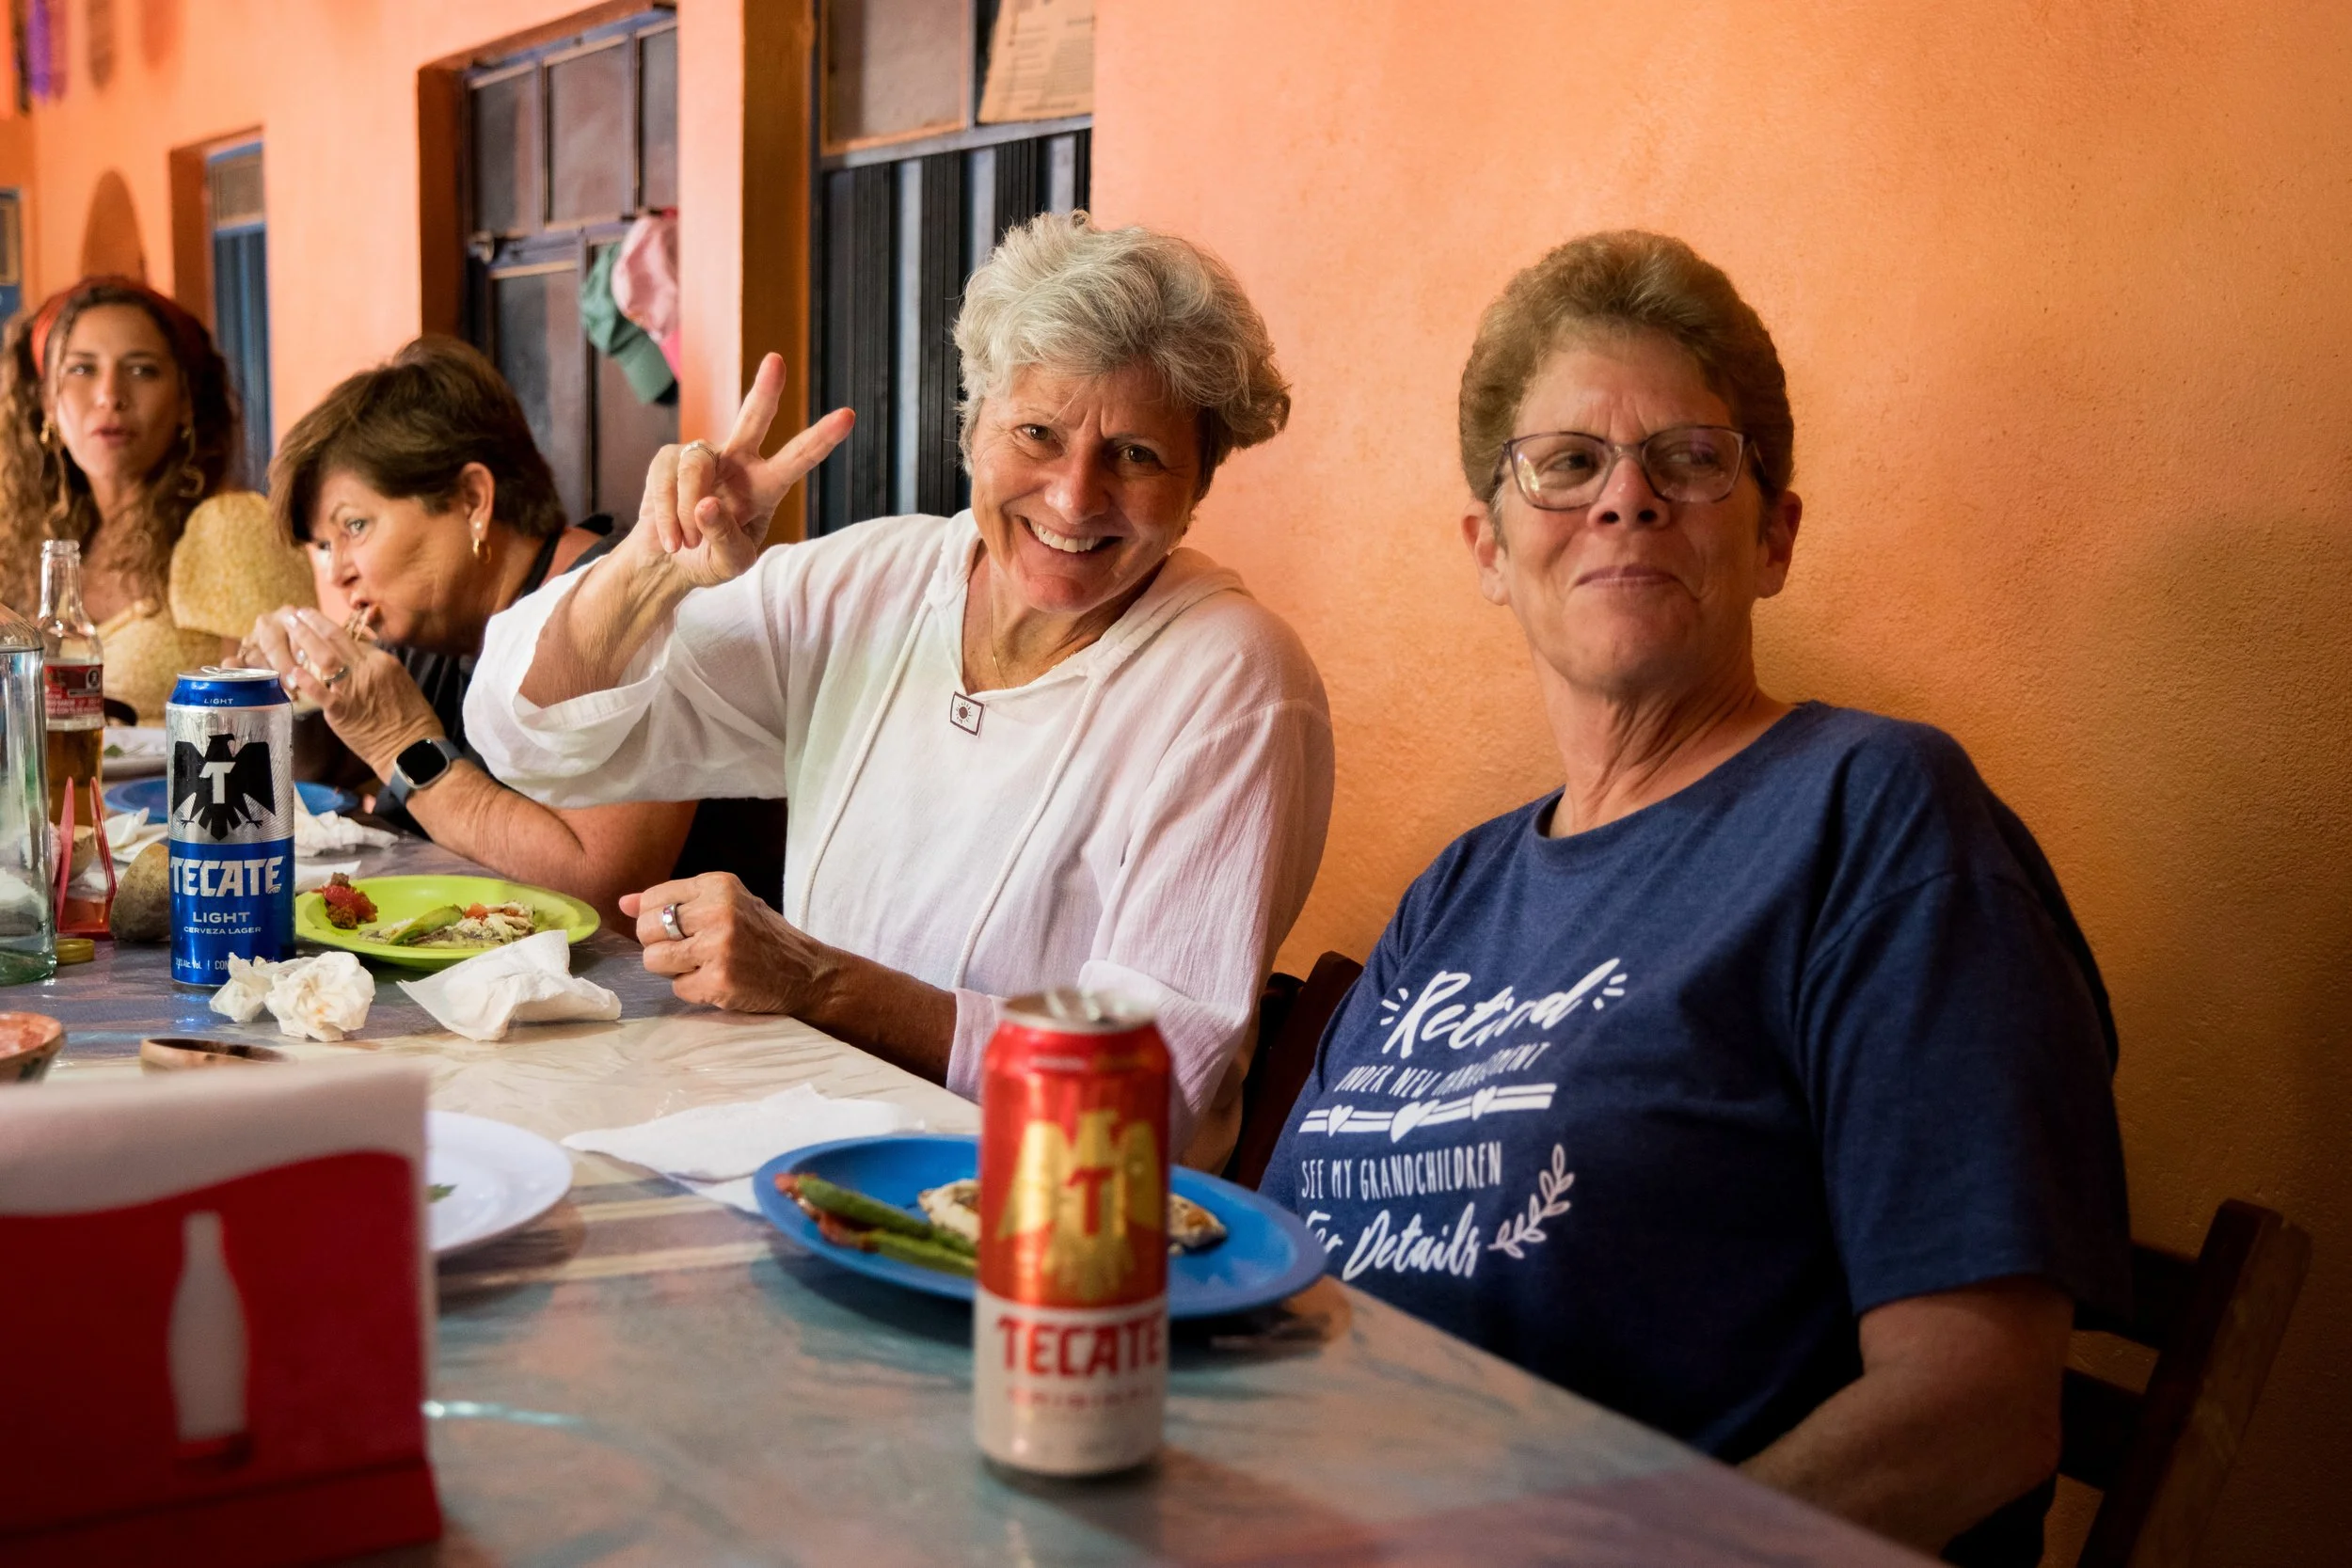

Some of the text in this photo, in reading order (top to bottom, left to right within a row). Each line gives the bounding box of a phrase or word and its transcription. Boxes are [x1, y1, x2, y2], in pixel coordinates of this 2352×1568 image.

[199, 761, 236, 804] T
[169, 856, 284, 897] TECATE
[183, 926, 262, 935] CERVEZA LAGER
[192, 911, 251, 924] LIGHT
[1388, 1066, 1443, 1100] NEW
[1301, 1140, 1502, 1201] SEE MY GRANDCHILDREN
[1342, 1201, 1481, 1279] Details
[996, 1310, 1166, 1379] TECATE
